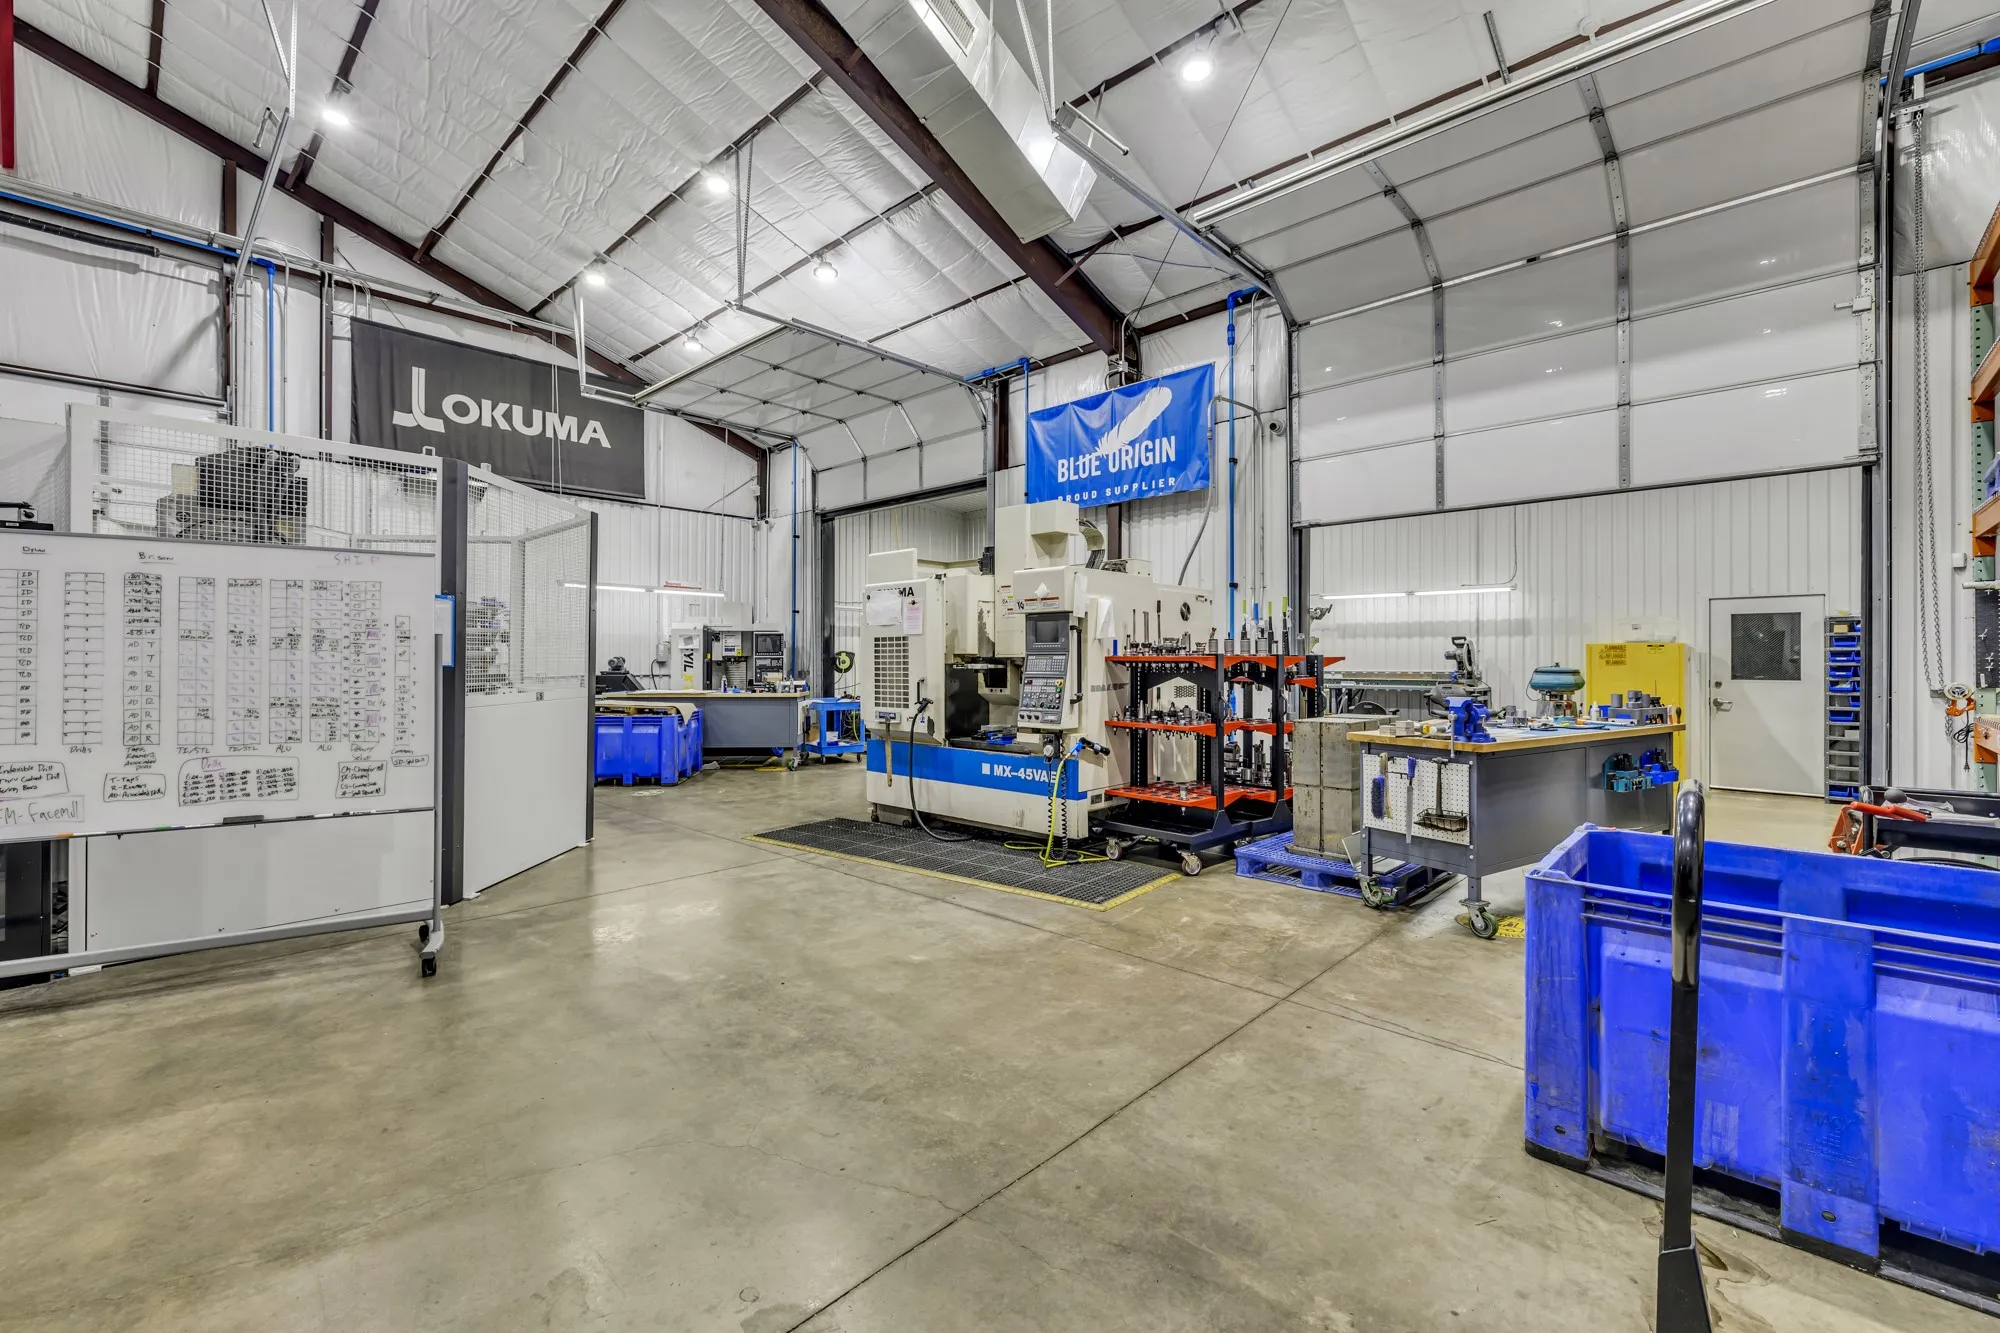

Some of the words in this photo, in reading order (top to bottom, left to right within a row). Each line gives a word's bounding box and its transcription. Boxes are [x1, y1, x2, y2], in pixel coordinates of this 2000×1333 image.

[1057, 453, 1101, 483] BLUE
[1108, 435, 1176, 473] ORIGIN
[1105, 477, 1175, 496] SUPPLIER
